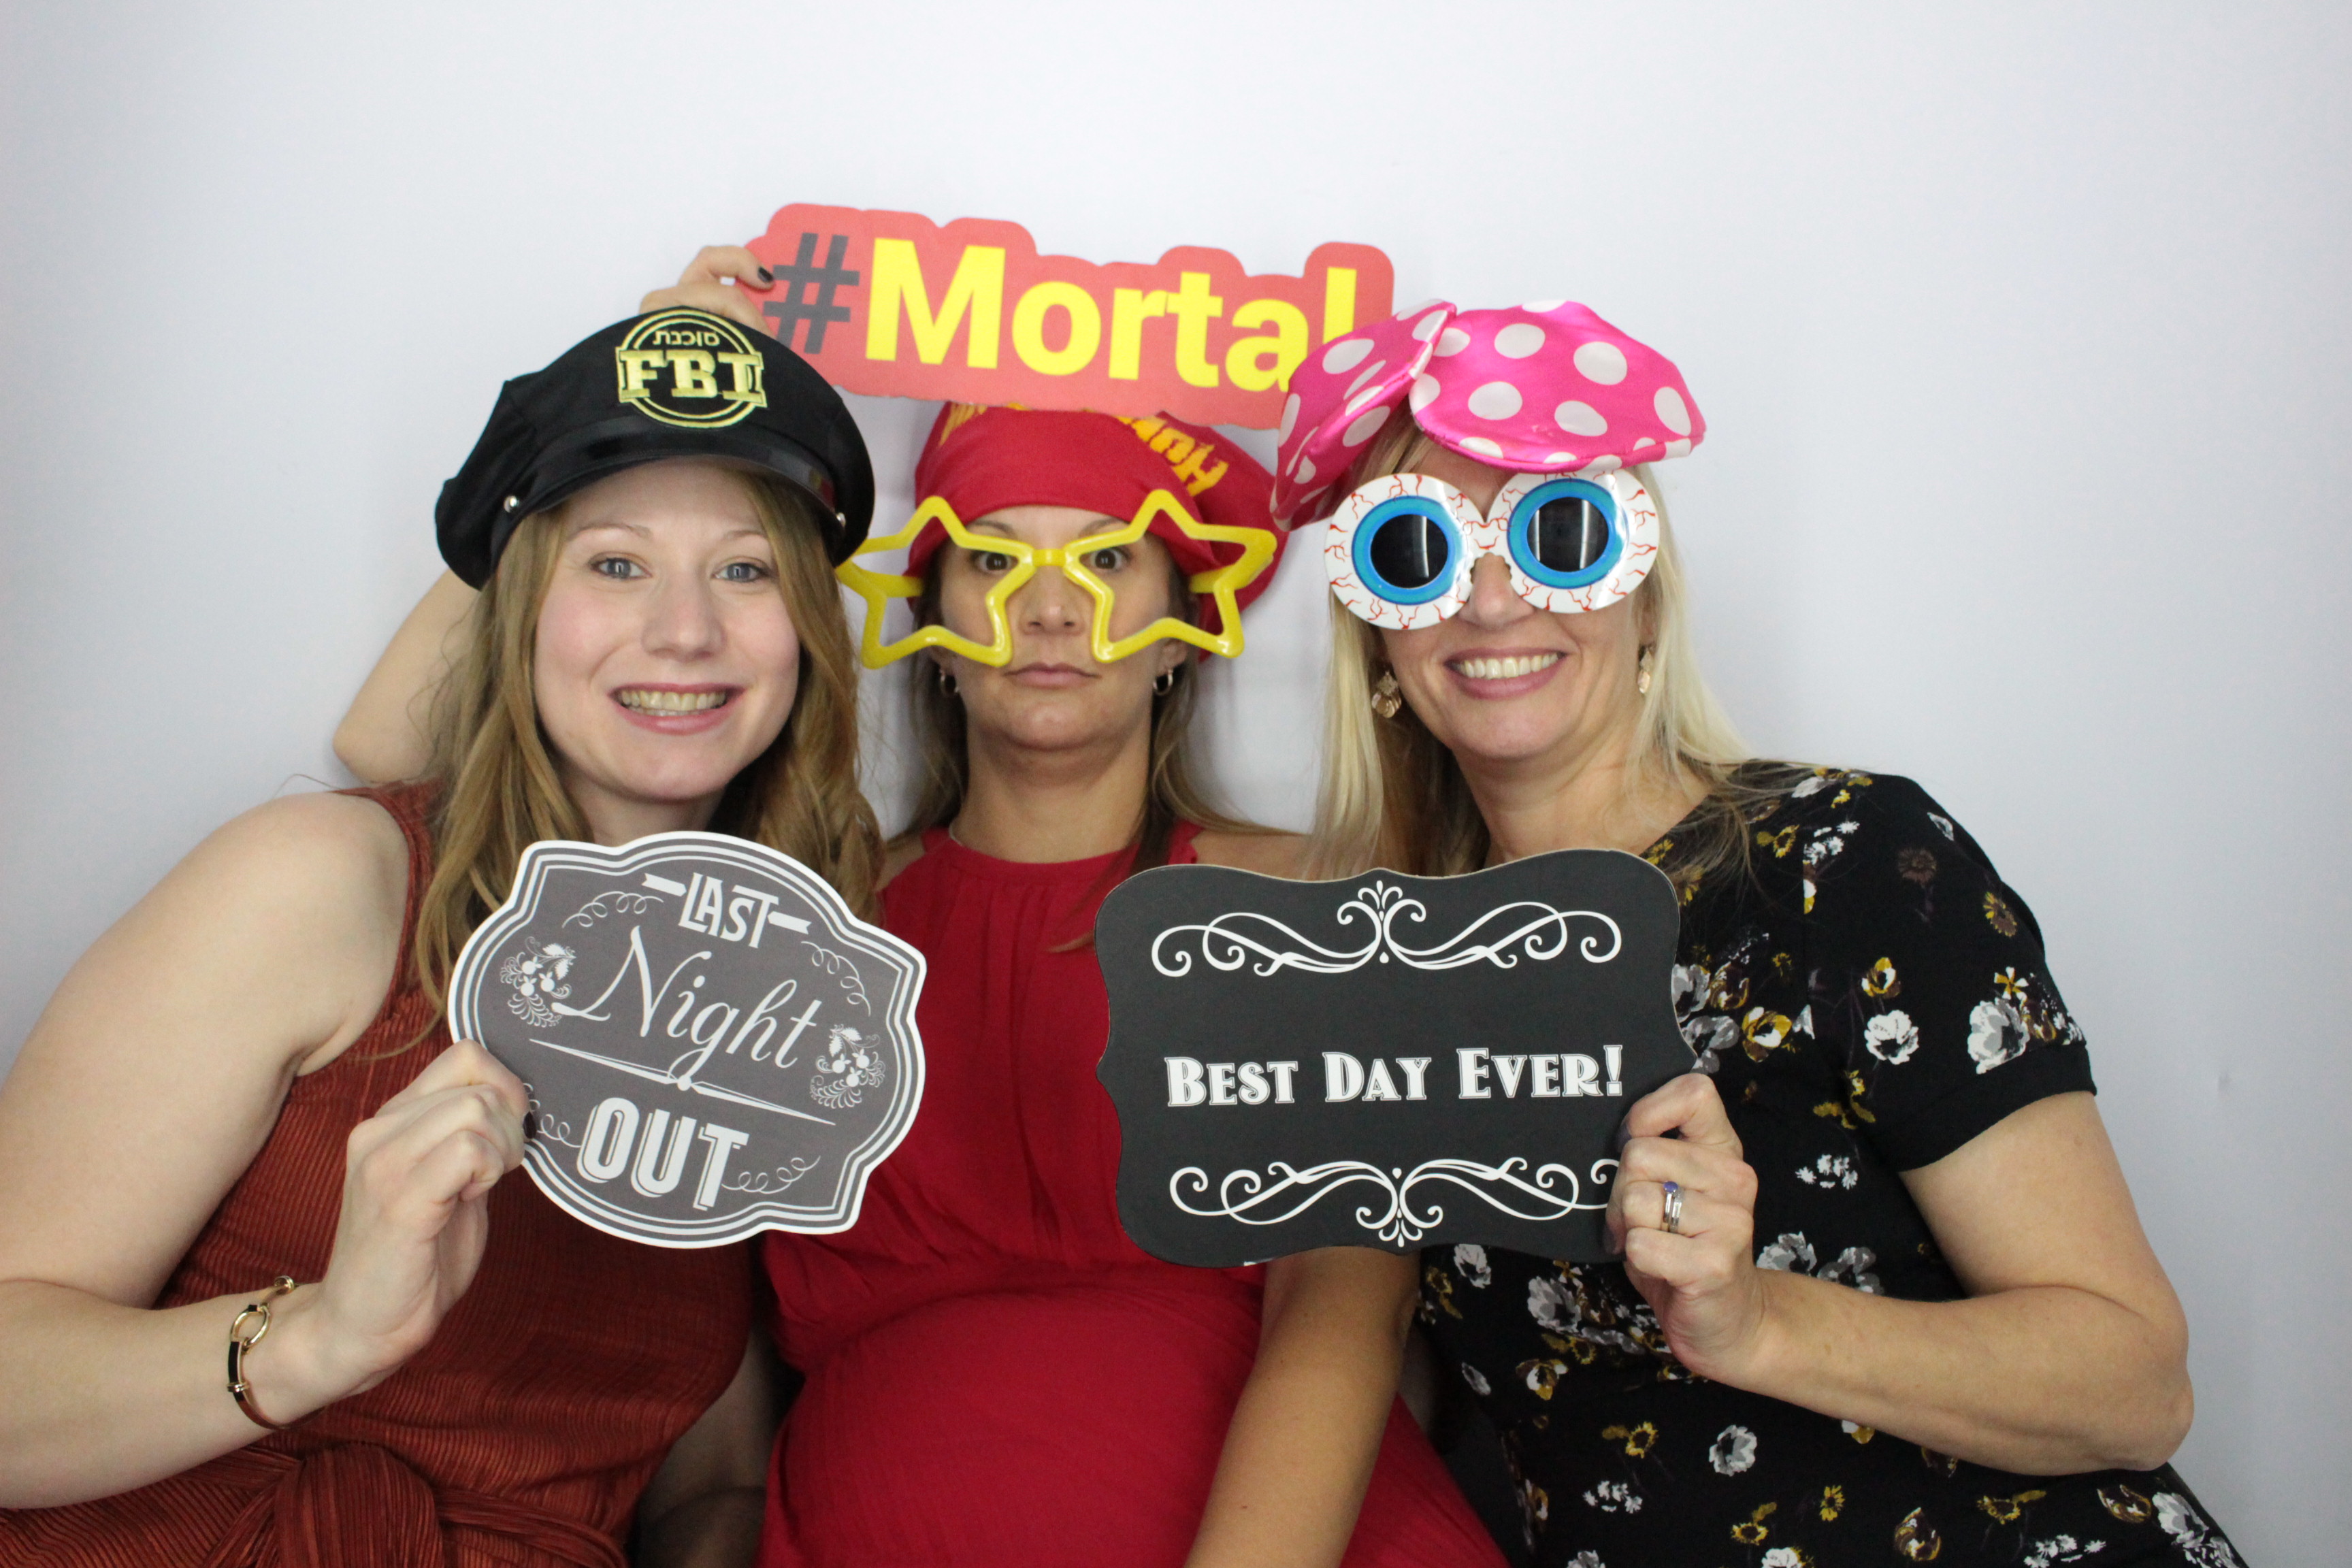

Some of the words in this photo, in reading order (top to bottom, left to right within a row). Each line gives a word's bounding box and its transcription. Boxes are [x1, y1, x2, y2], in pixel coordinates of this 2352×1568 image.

[652, 329, 721, 346] סוכנת
[619, 349, 764, 403] FBI
[678, 872, 779, 949] LAST
[551, 925, 823, 1081] Night
[1164, 1056, 1299, 1107] BEST
[1322, 1051, 1433, 1102] DAY
[1455, 1044, 1623, 1099] EVER!
[576, 1097, 750, 1211] OUT
